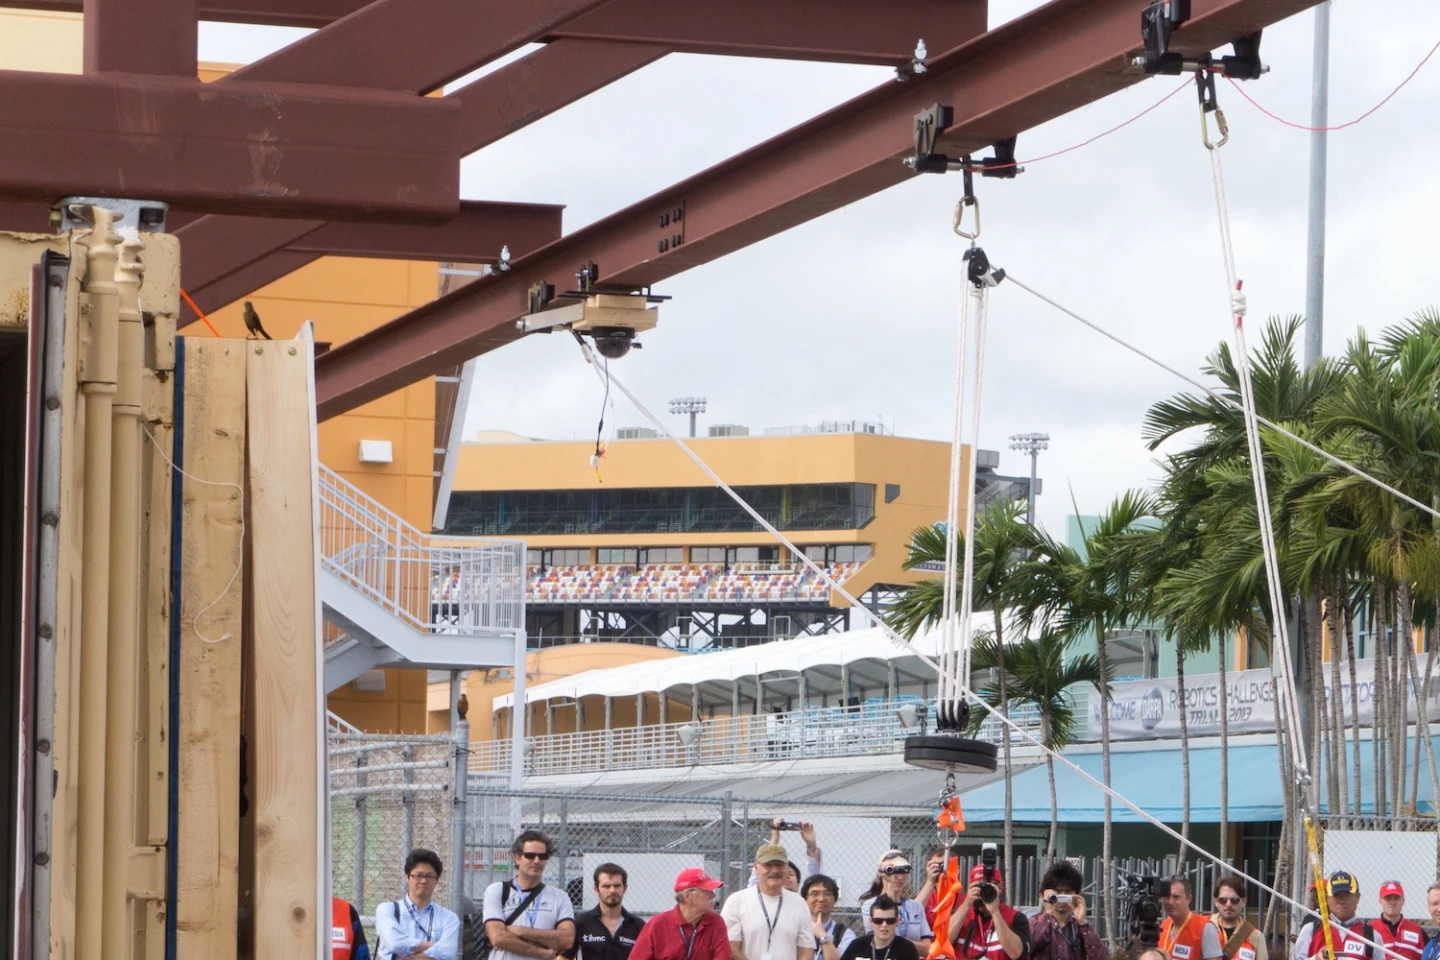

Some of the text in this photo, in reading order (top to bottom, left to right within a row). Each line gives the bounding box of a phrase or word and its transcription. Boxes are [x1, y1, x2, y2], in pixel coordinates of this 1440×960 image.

[1174, 945, 1189, 956] MEDIA
[1347, 943, 1362, 952] DV
[1241, 950, 1254, 960] MEDIA
